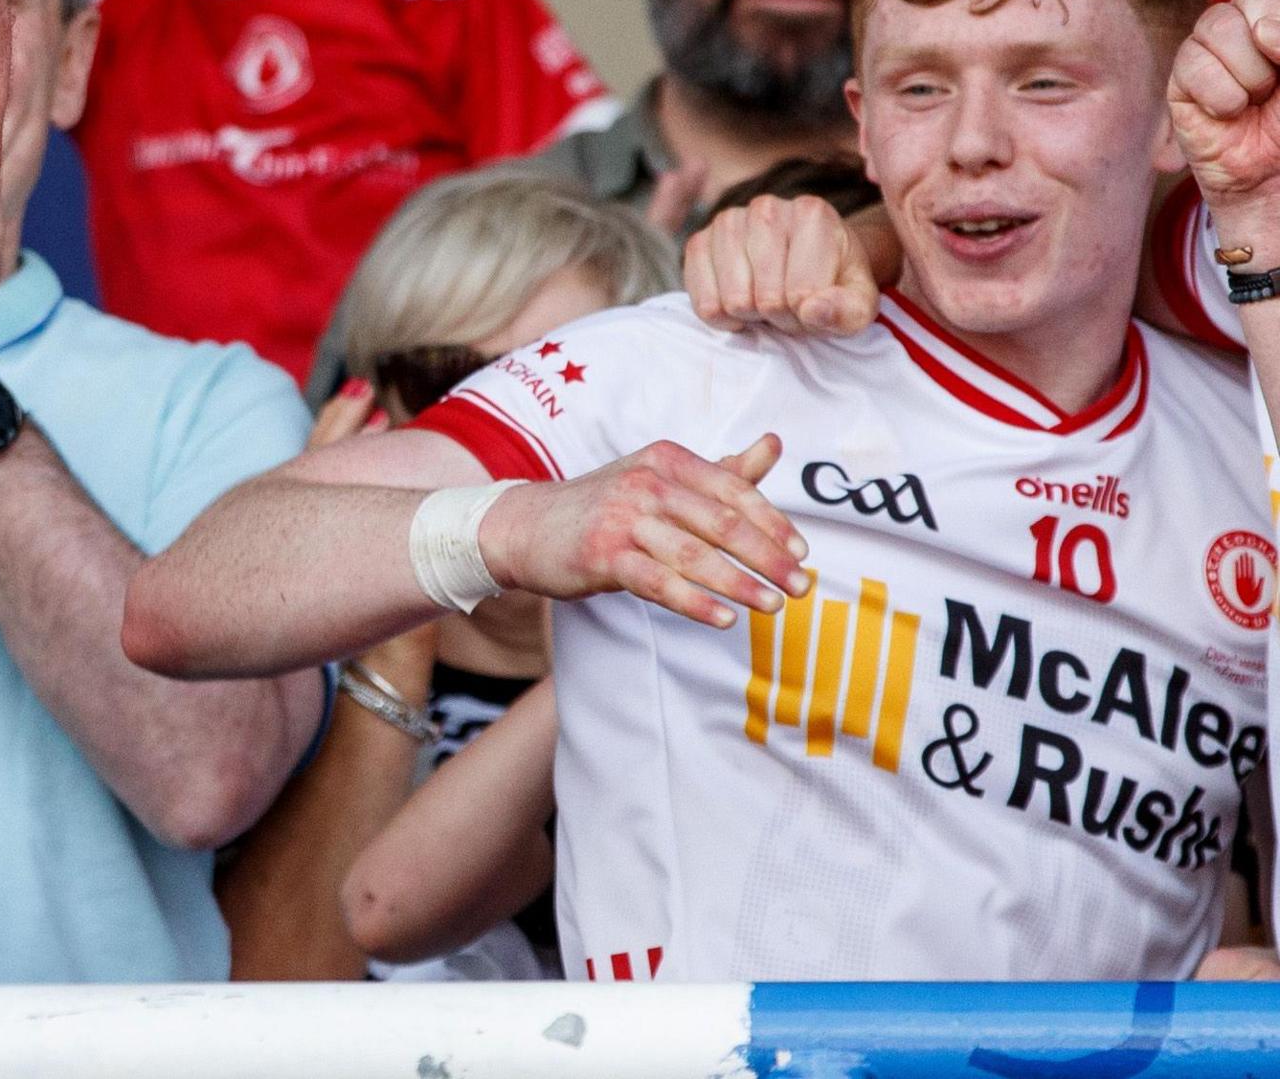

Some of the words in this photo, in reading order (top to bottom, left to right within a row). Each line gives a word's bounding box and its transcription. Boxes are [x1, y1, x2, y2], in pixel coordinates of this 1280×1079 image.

[801, 461, 939, 532] GAA
[1029, 515, 1117, 605] 10
[940, 598, 1267, 788] McAlee
[921, 702, 994, 799] &
